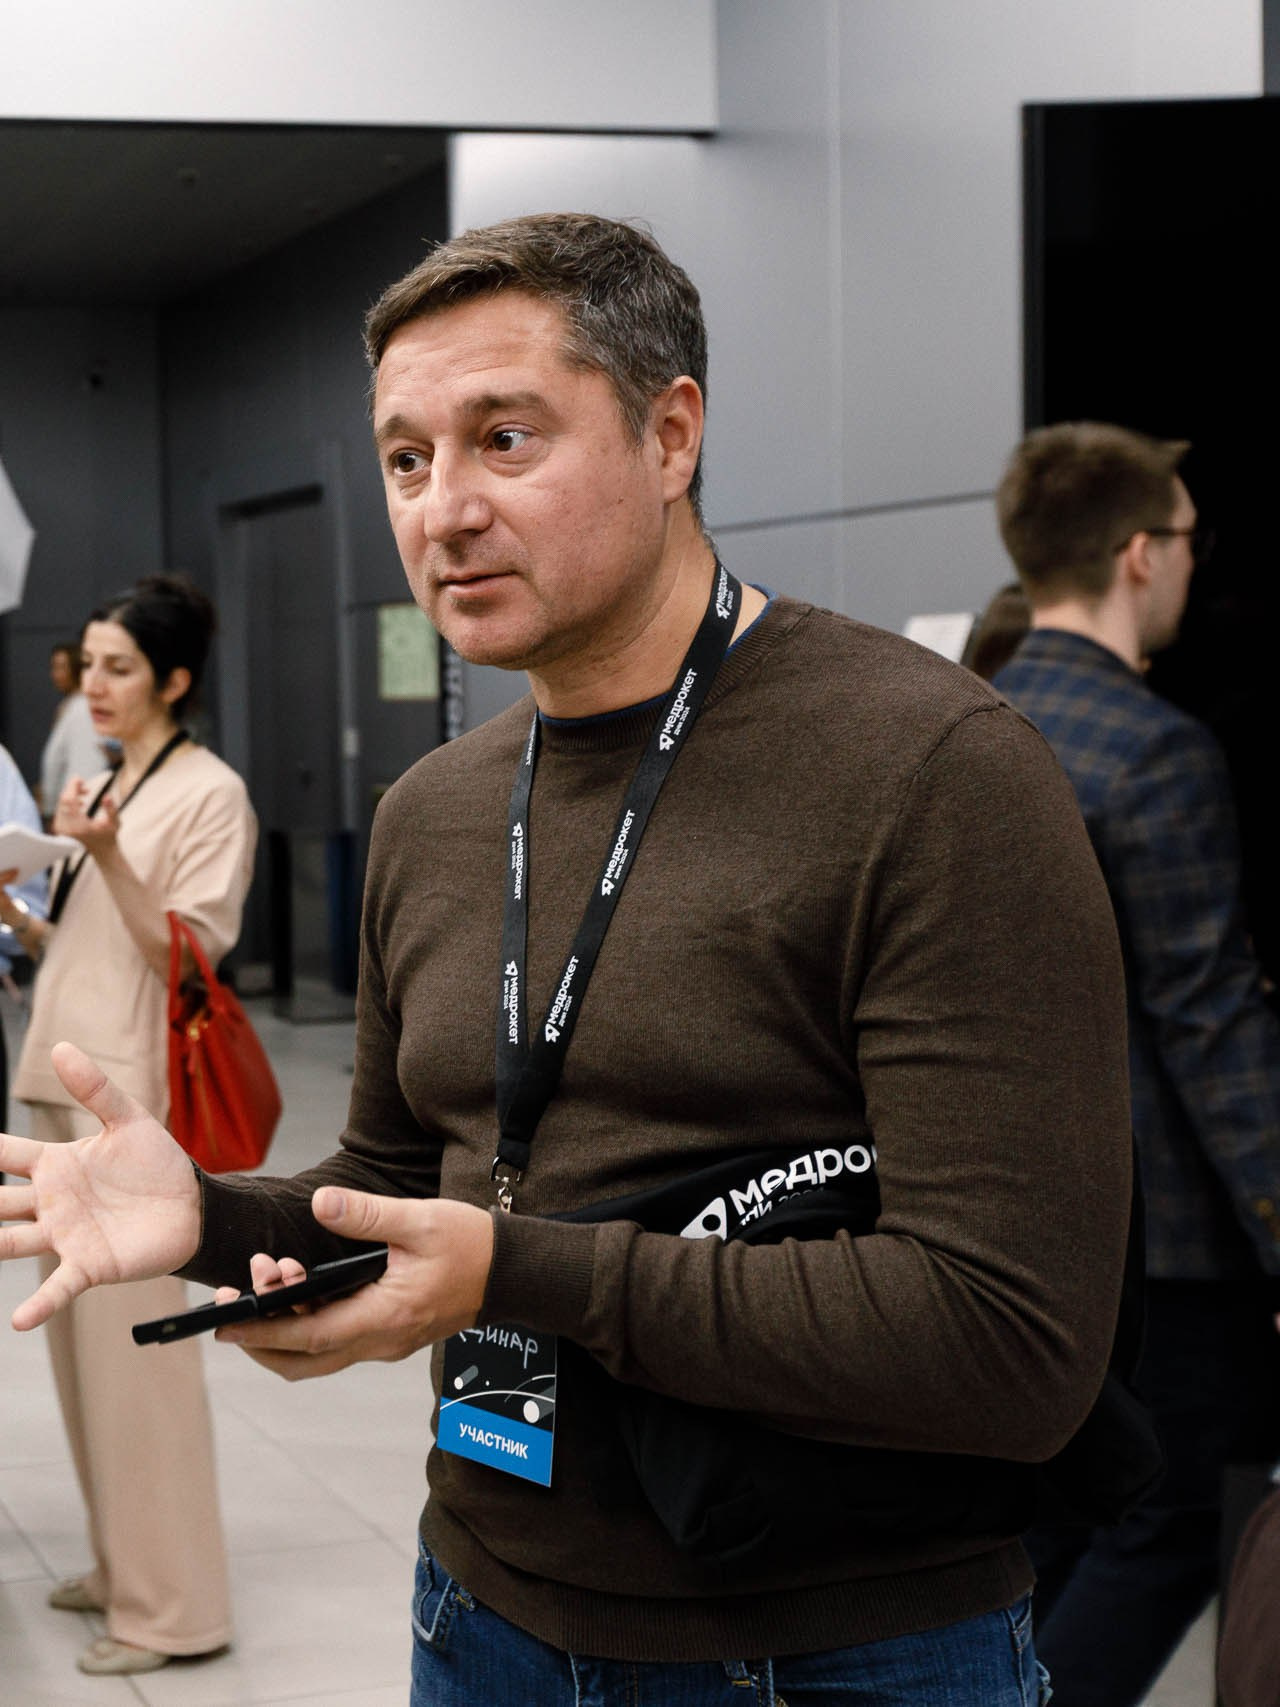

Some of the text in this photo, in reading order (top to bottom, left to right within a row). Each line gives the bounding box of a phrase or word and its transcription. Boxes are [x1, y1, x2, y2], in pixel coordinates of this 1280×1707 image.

[662, 668, 697, 734] медрокет
[604, 809, 636, 878] медрокет
[508, 976, 519, 1045] медрокет
[547, 955, 579, 1024] медрокет
[729, 1145, 877, 1216] медро
[459, 1422, 529, 1459] УЧАСТНИК
